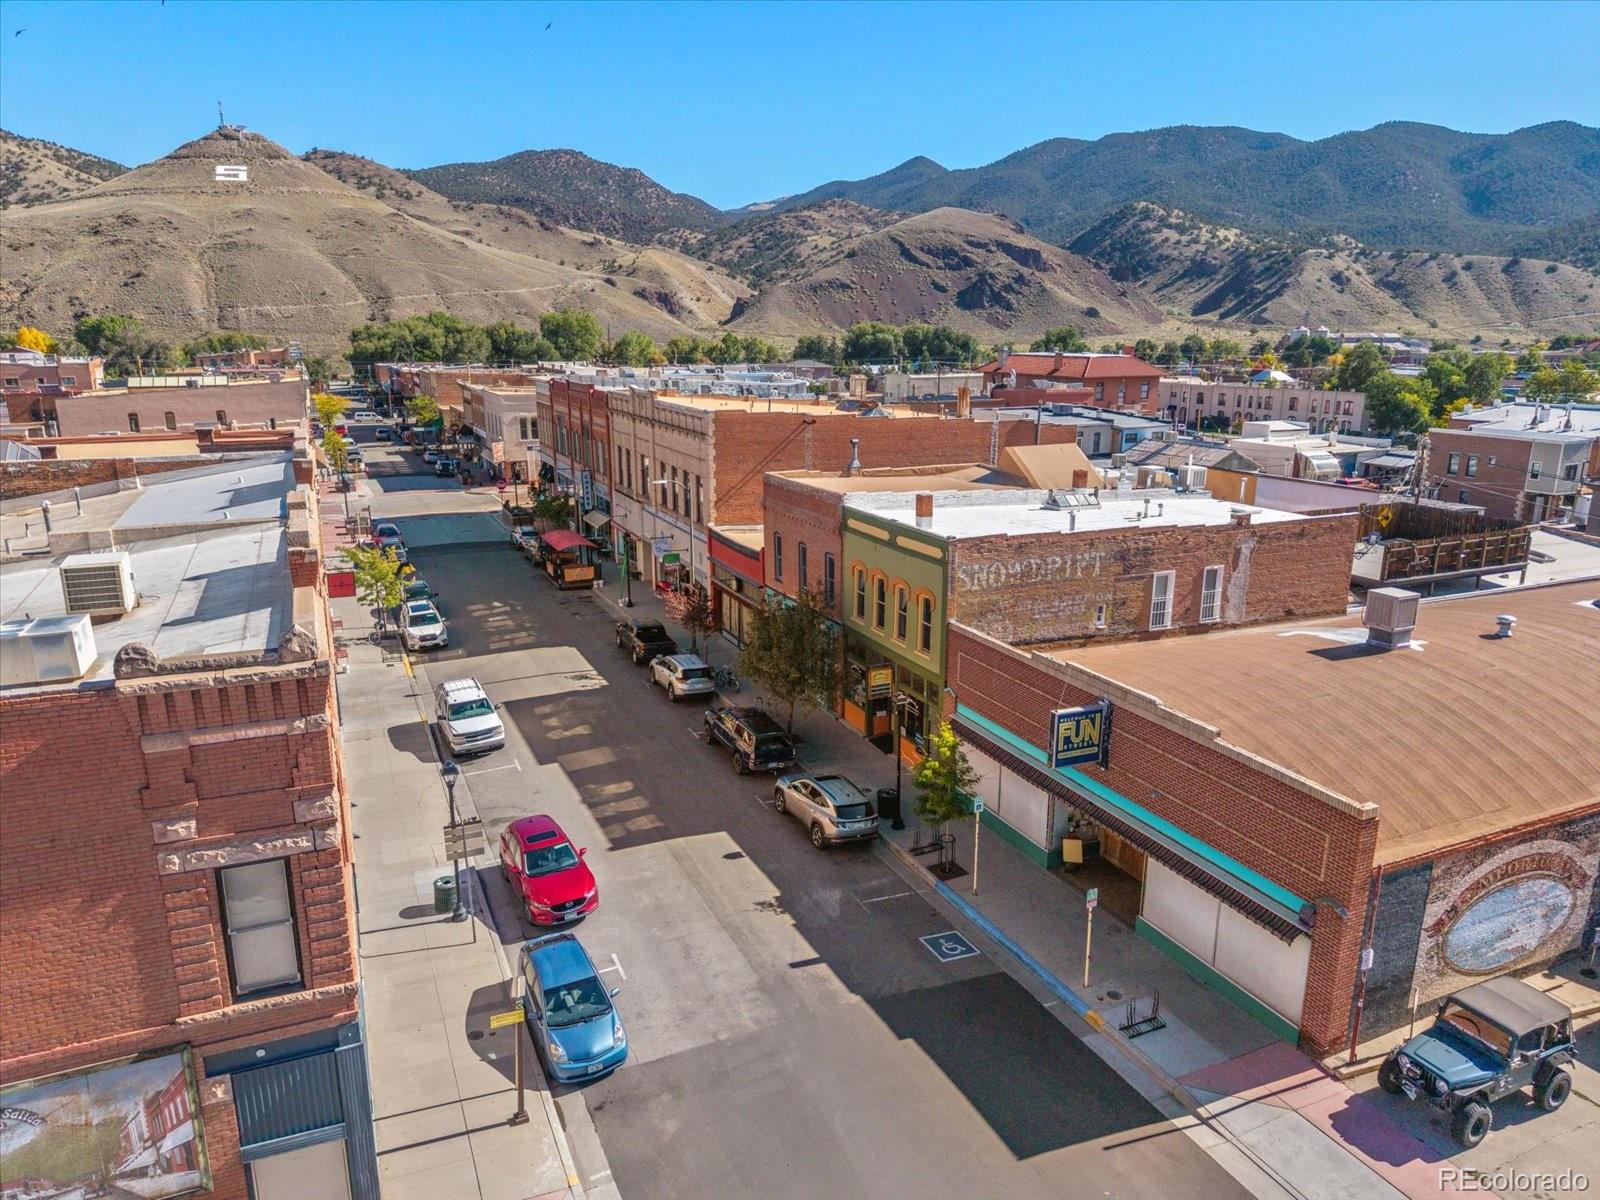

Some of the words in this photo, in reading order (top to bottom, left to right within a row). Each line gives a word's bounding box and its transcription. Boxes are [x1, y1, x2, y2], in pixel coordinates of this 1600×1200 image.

[1059, 712, 1101, 750] FUN
[1064, 741, 1093, 750] STREET
[2, 1109, 42, 1126] Salida
